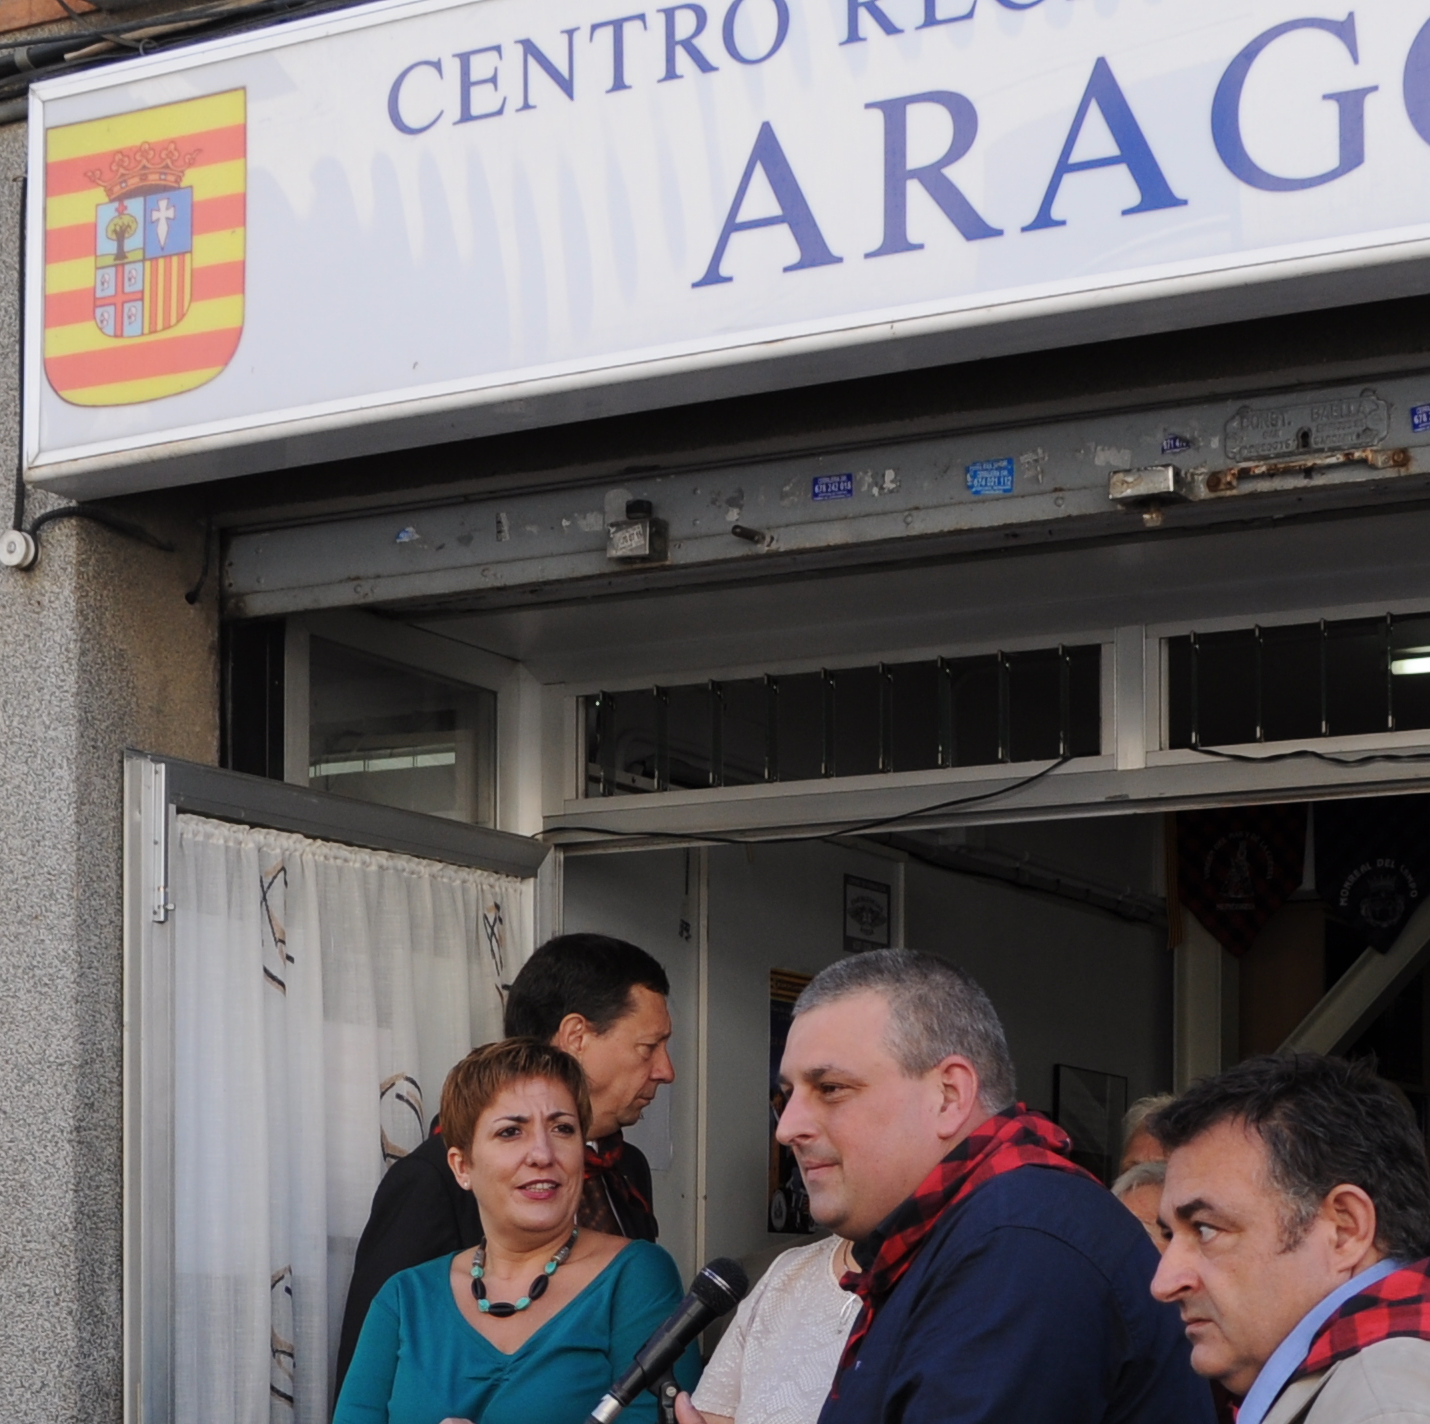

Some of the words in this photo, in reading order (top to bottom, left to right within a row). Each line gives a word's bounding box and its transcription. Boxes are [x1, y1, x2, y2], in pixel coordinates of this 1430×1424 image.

[387, 0, 791, 135] CENTRO
[1339, 862, 1372, 906] MONREAL
[1376, 858, 1396, 869] DEL
